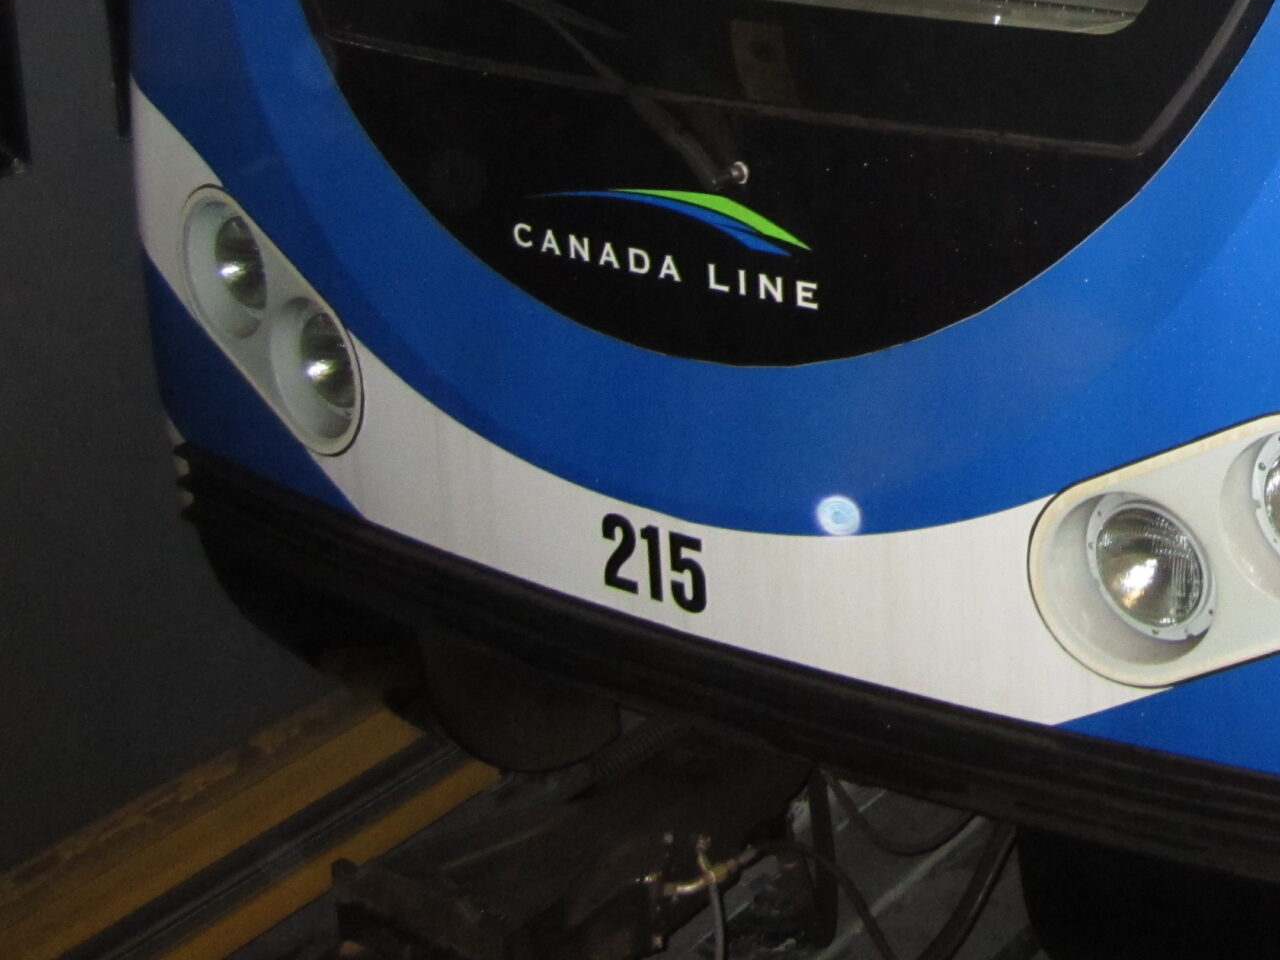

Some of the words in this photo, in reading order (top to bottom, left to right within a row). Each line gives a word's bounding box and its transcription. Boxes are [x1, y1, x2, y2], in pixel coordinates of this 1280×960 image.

[512, 222, 682, 283] CANADA
[707, 263, 820, 310] LINE
[601, 512, 707, 614] 215
